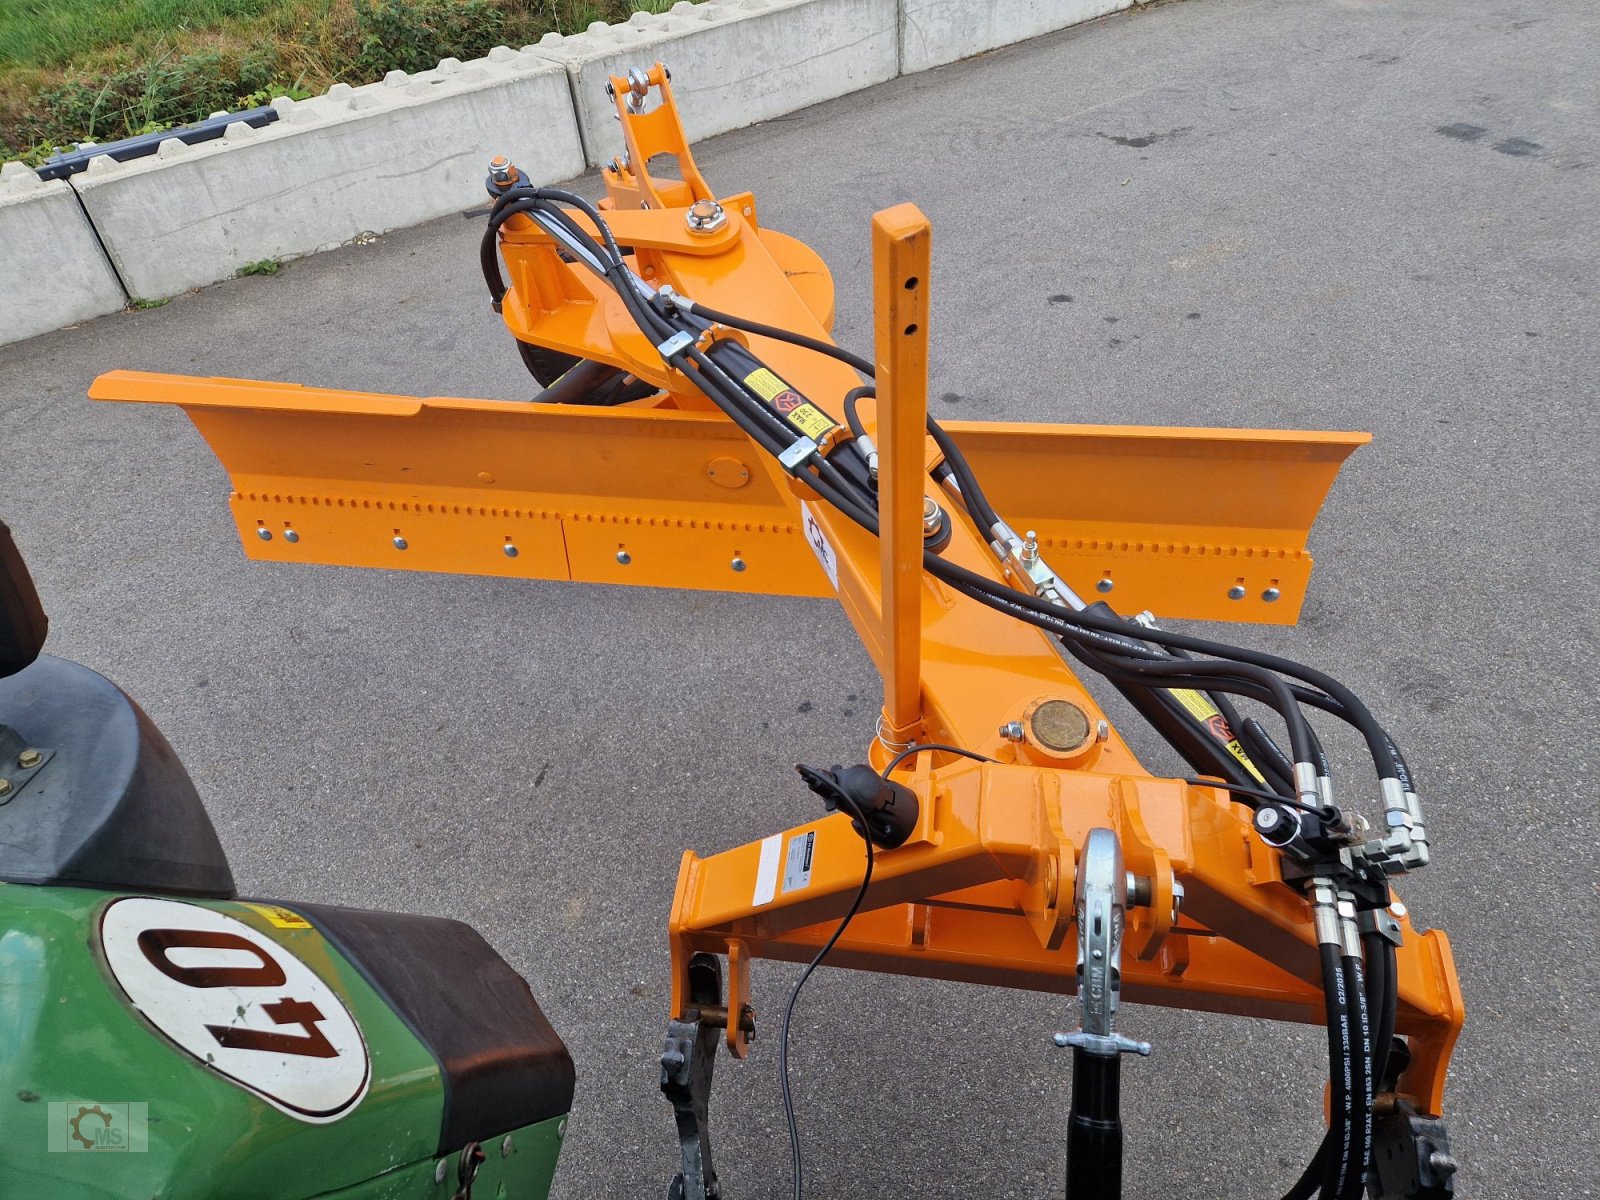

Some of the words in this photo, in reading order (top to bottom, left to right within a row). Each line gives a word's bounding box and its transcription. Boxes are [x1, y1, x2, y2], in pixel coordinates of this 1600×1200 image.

[791, 411, 806, 425] MAX
[138, 928, 340, 1058] 40
[1362, 1025, 1369, 1036] 10
[1363, 1038, 1371, 1052] DN
